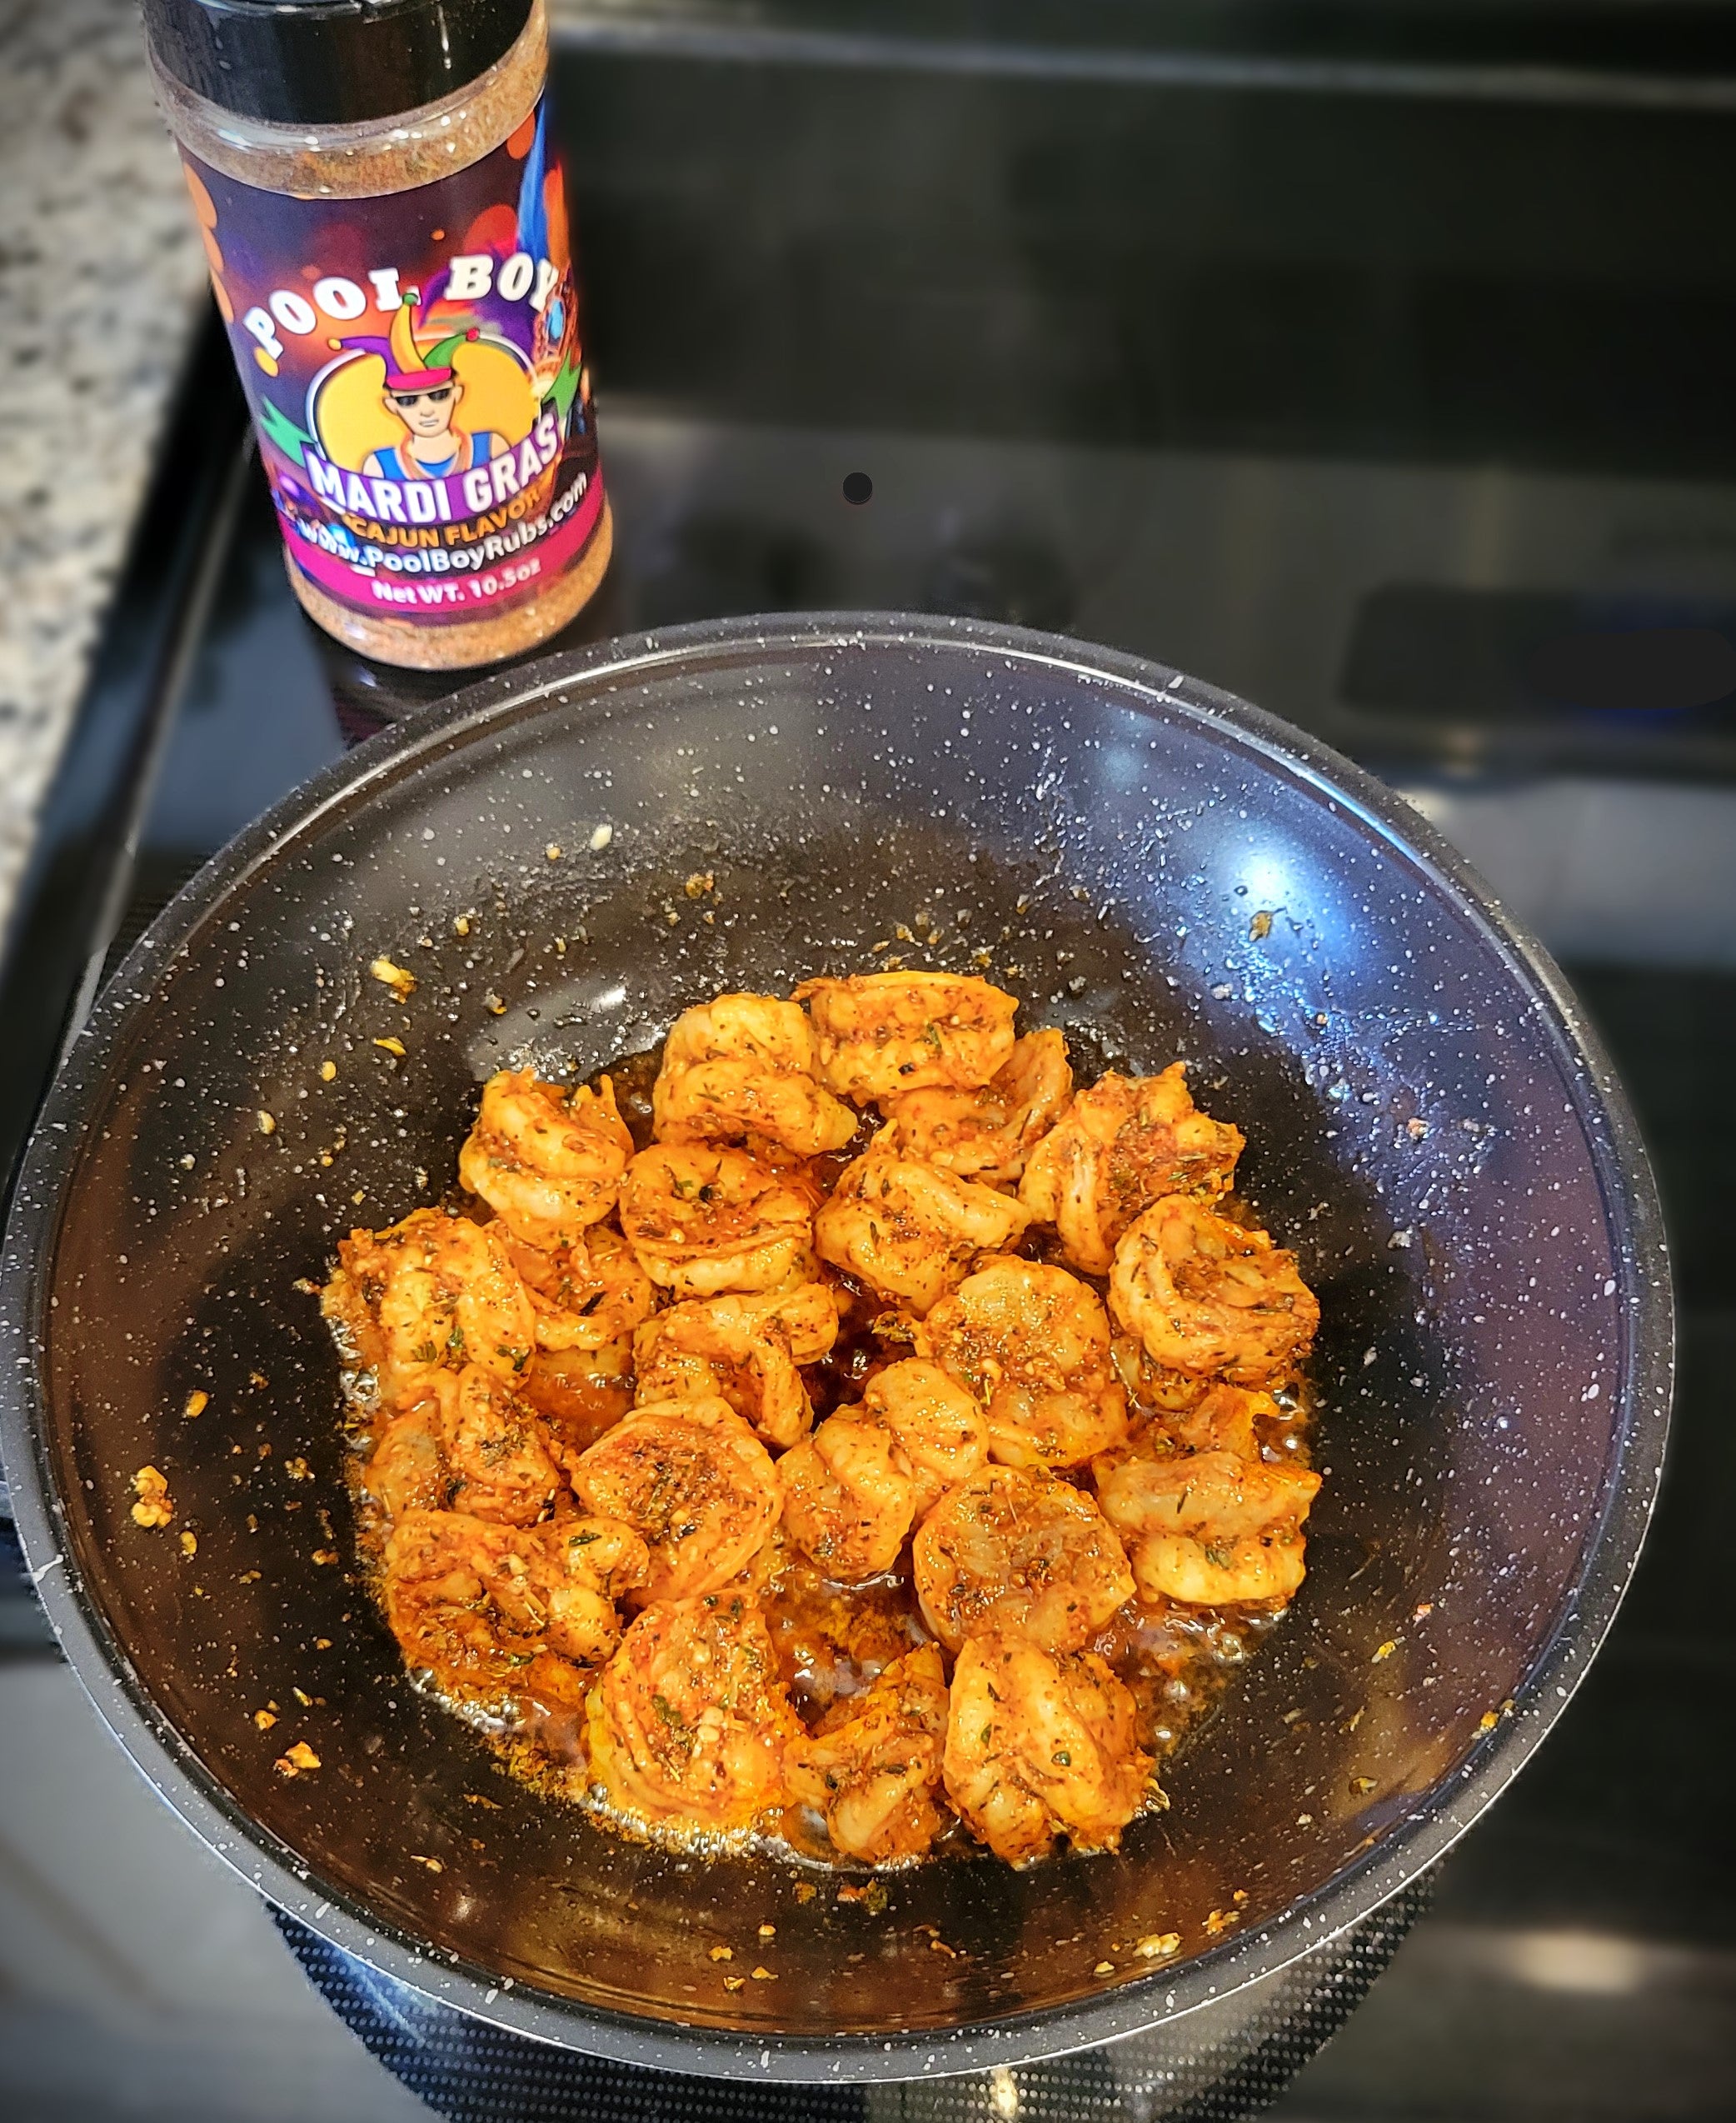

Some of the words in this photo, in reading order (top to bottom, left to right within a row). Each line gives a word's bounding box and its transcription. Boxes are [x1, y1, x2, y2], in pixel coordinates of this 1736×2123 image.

[242, 267, 420, 360] POOL
[444, 252, 559, 311] BOY
[307, 451, 451, 523] MARDI
[463, 417, 558, 513] GRAS
[344, 513, 440, 547] CAJUN
[444, 488, 541, 546] FLAVOR
[296, 471, 587, 573] www.PoolBoyRubs.com
[372, 580, 417, 604] Net
[417, 583, 465, 604] WT.
[468, 557, 541, 599] 10.5oz
